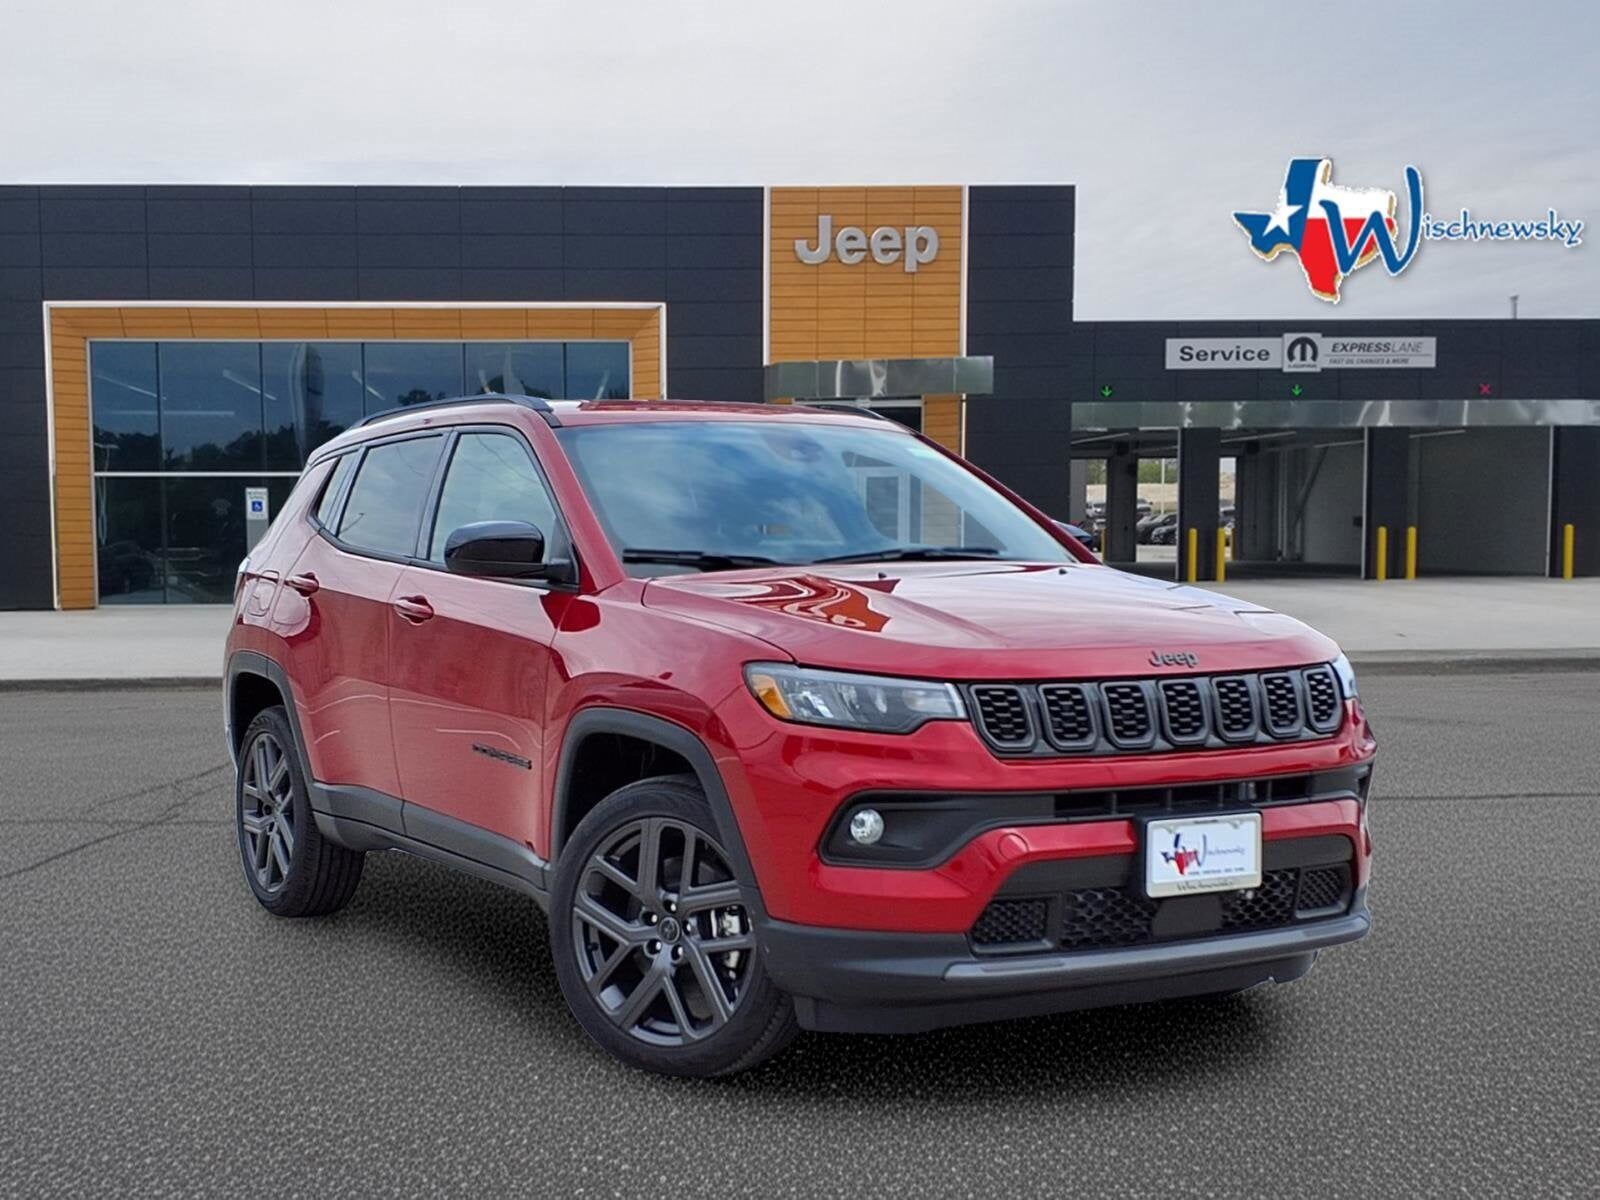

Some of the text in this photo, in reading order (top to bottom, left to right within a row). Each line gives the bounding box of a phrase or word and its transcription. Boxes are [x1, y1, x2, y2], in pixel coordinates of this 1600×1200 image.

[794, 214, 940, 272] Jeep
[1179, 345, 1271, 361] Service
[1148, 650, 1200, 669] Jeep
